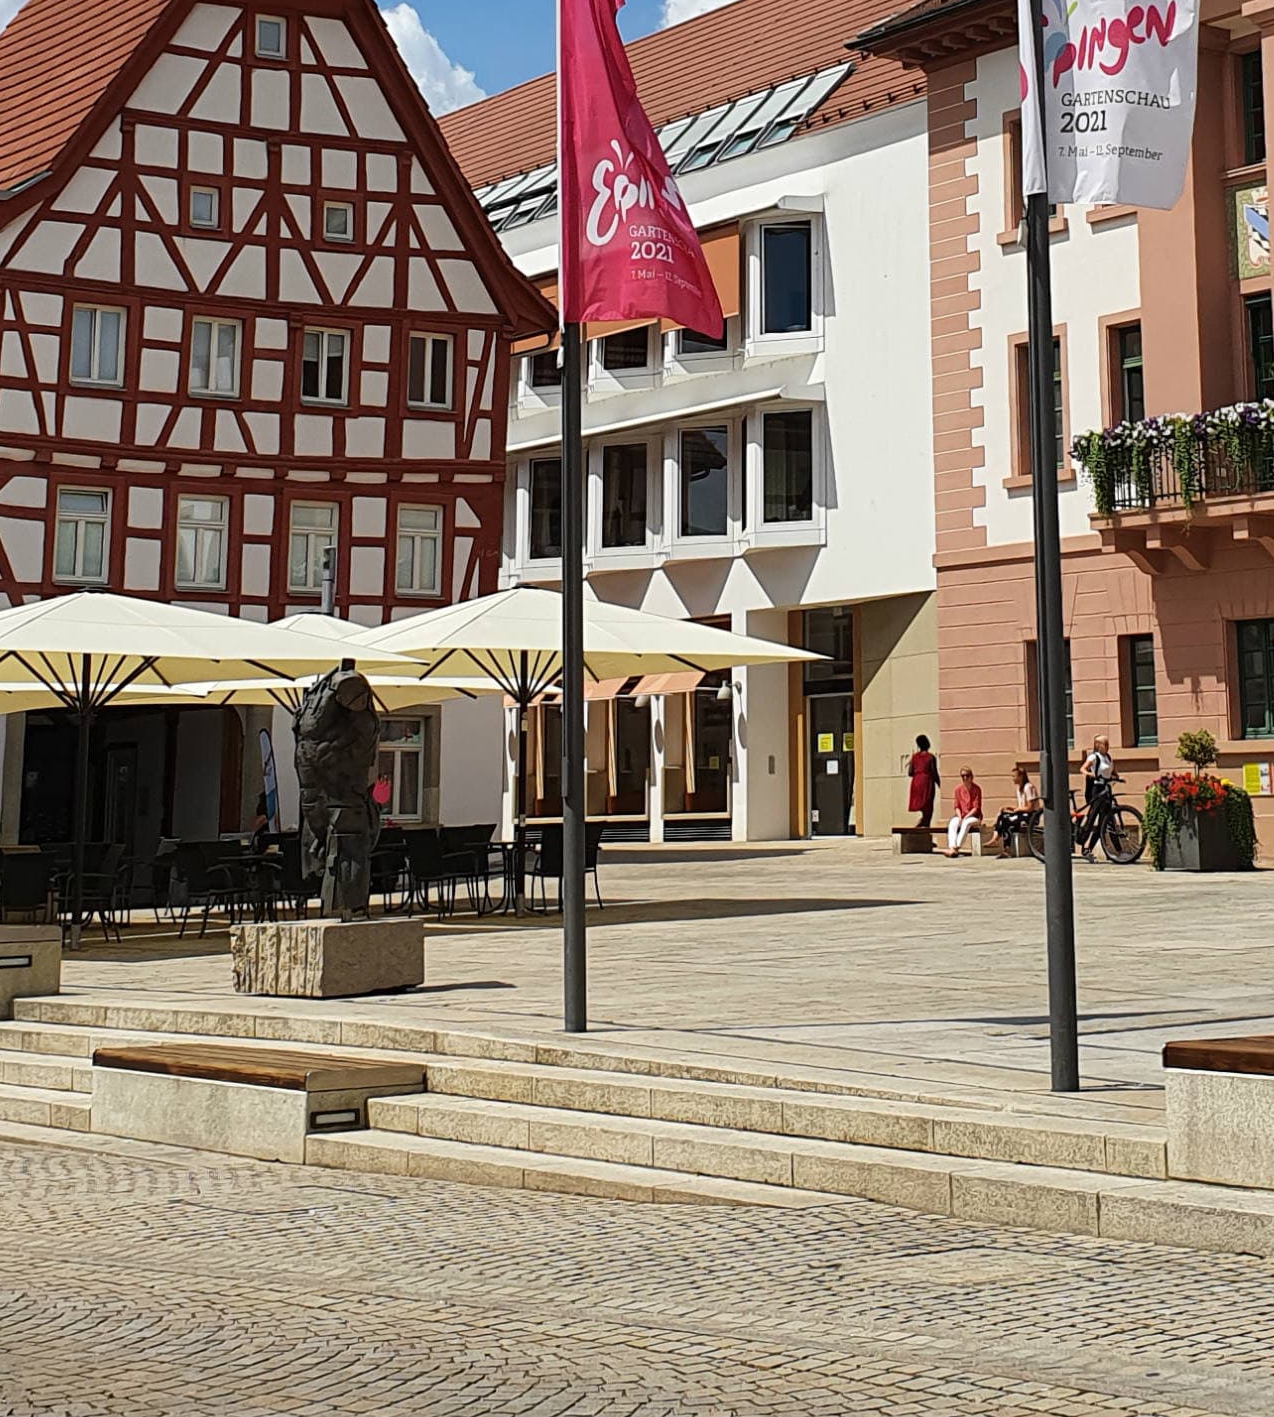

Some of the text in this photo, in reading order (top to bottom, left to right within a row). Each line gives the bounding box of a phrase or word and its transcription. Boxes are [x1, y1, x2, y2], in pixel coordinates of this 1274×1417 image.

[1060, 89, 1171, 110] GARTENSCHAU
[1060, 110, 1107, 134] 2021
[1106, 143, 1164, 162] September
[631, 241, 675, 264] 2021
